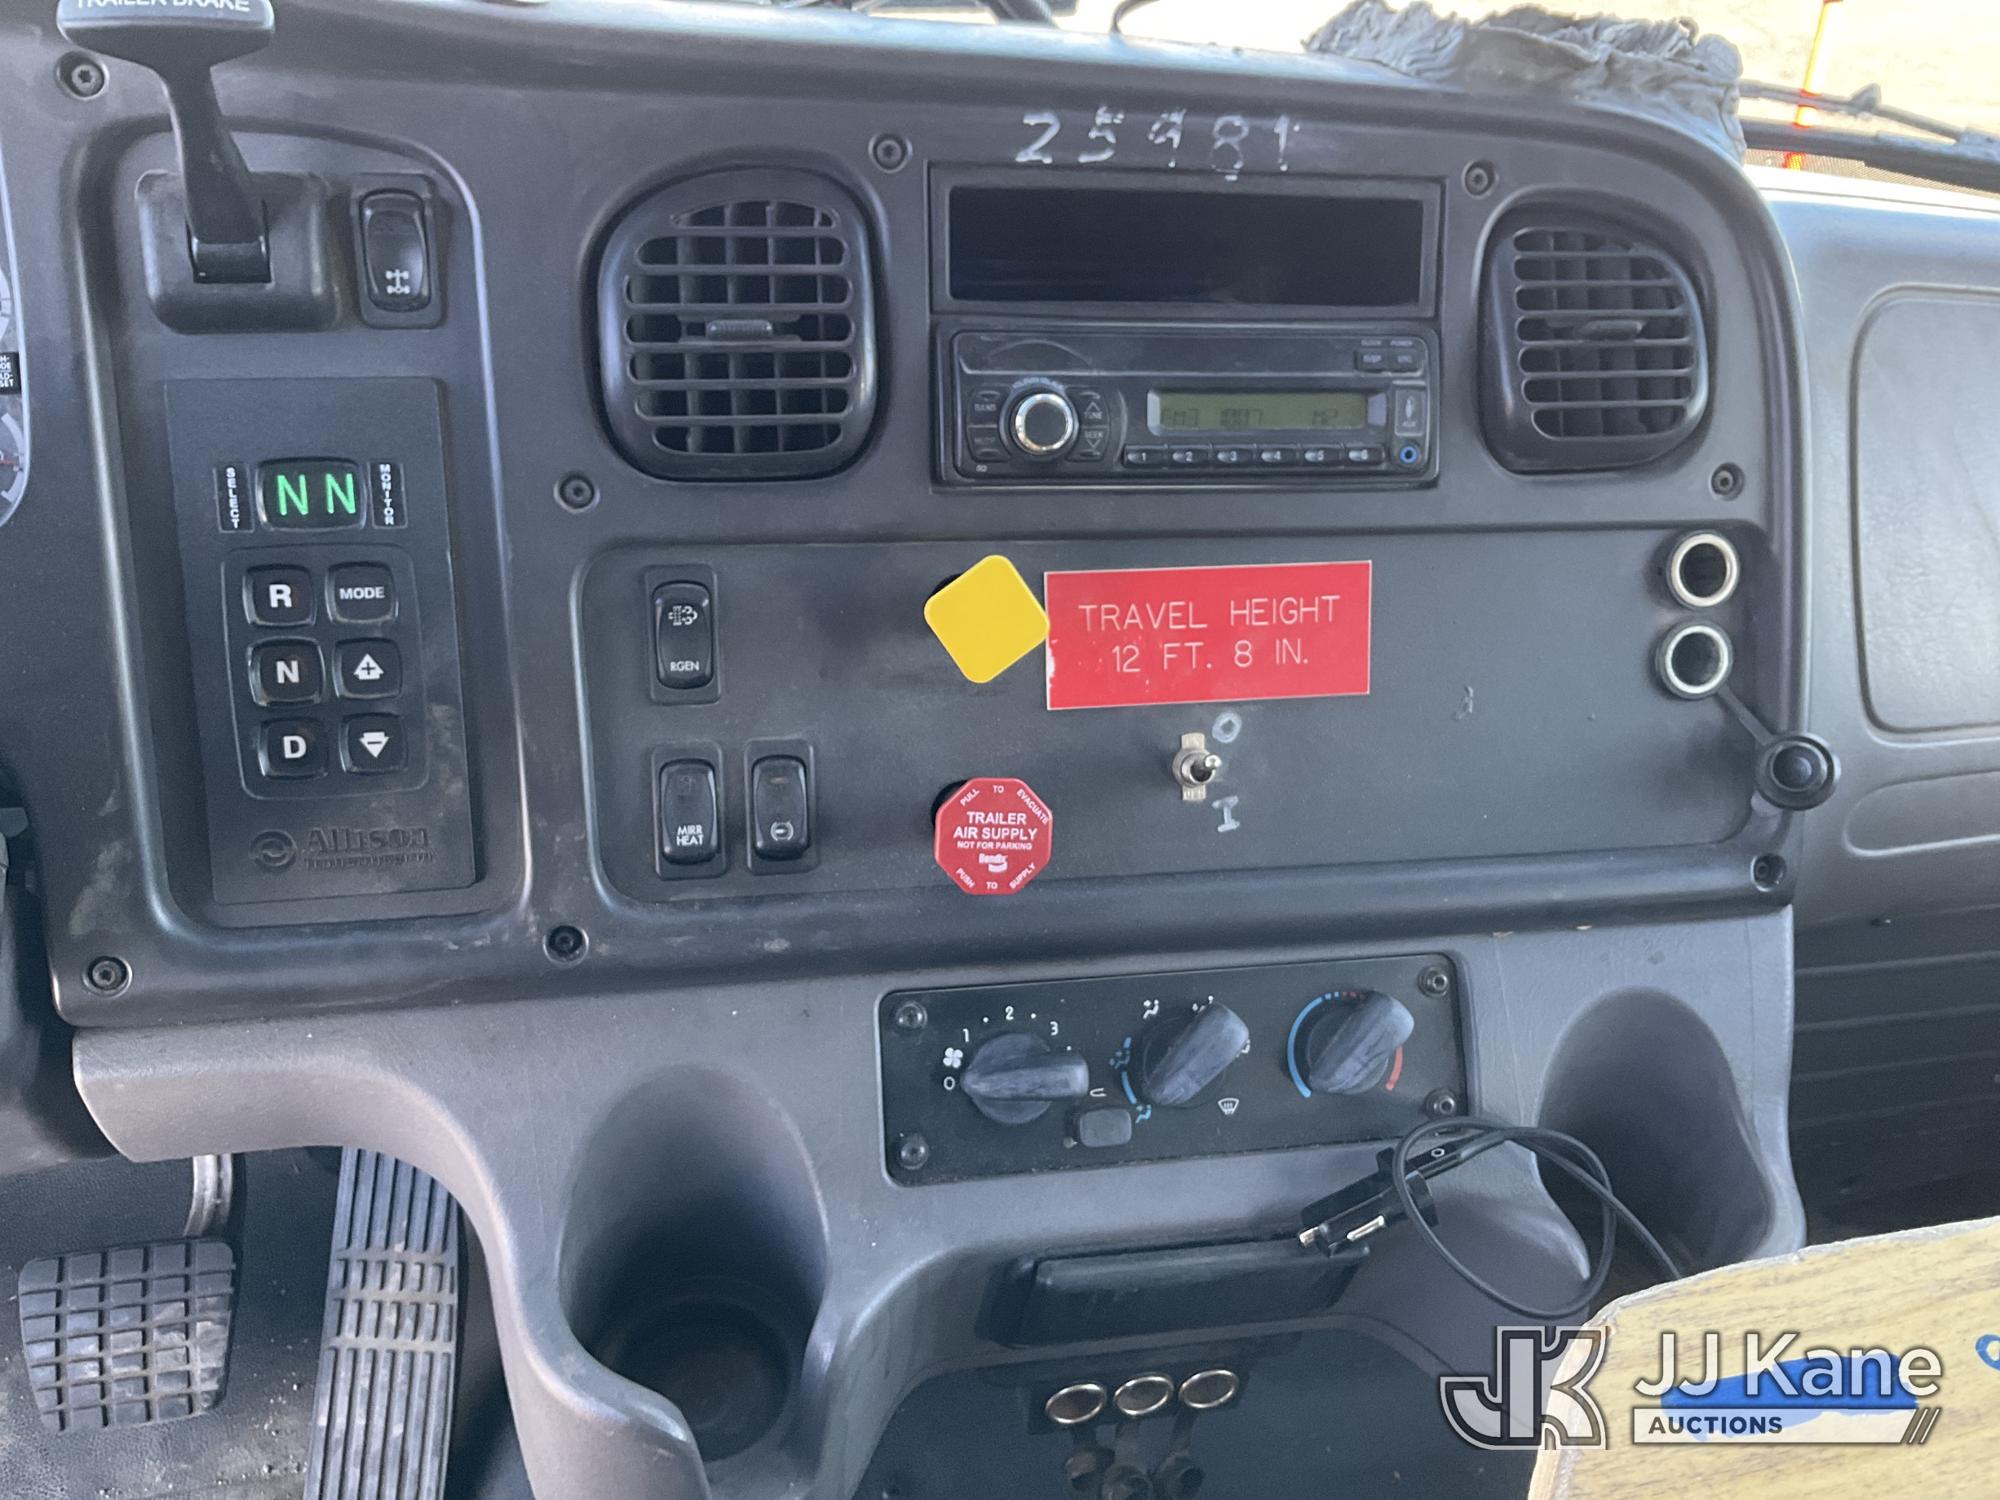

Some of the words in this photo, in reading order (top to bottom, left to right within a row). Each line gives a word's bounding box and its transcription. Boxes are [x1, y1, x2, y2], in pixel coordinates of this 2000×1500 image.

[1185, 451, 1193, 462] 2
[1229, 450, 1237, 461] 3
[226, 467, 241, 529] SELECT
[276, 474, 309, 516] N
[324, 472, 356, 514] N
[379, 463, 395, 526] MONITOR
[269, 584, 292, 608] R
[339, 586, 385, 600] MODE
[1078, 600, 1208, 632] TRAVEL
[1229, 594, 1341, 627] HEIGHT
[1111, 644, 1141, 673] 12
[1160, 641, 1213, 671] FT.
[1233, 639, 1254, 668] 8
[1274, 637, 1309, 665] IN.
[276, 660, 300, 684] N
[670, 661, 699, 672] RGEN
[283, 735, 307, 759] D
[960, 788, 980, 806] PULL
[993, 785, 1004, 793] TO
[1016, 788, 1050, 825] EVACUATE
[966, 811, 1027, 825] TRAILER
[676, 824, 703, 836] MIRR
[953, 827, 978, 839] AIR
[981, 827, 1038, 841] SUPPLY
[676, 834, 704, 847] HEAT
[957, 841, 975, 849] NOT
[977, 842, 994, 850] FOR
[996, 842, 1033, 850] PARKING
[955, 867, 976, 889] PUSH
[1008, 861, 1036, 890] SUPPLY
[1004, 1005, 1015, 1021] 2
[962, 1028, 970, 1043] 1
[1050, 1021, 1060, 1036] 3
